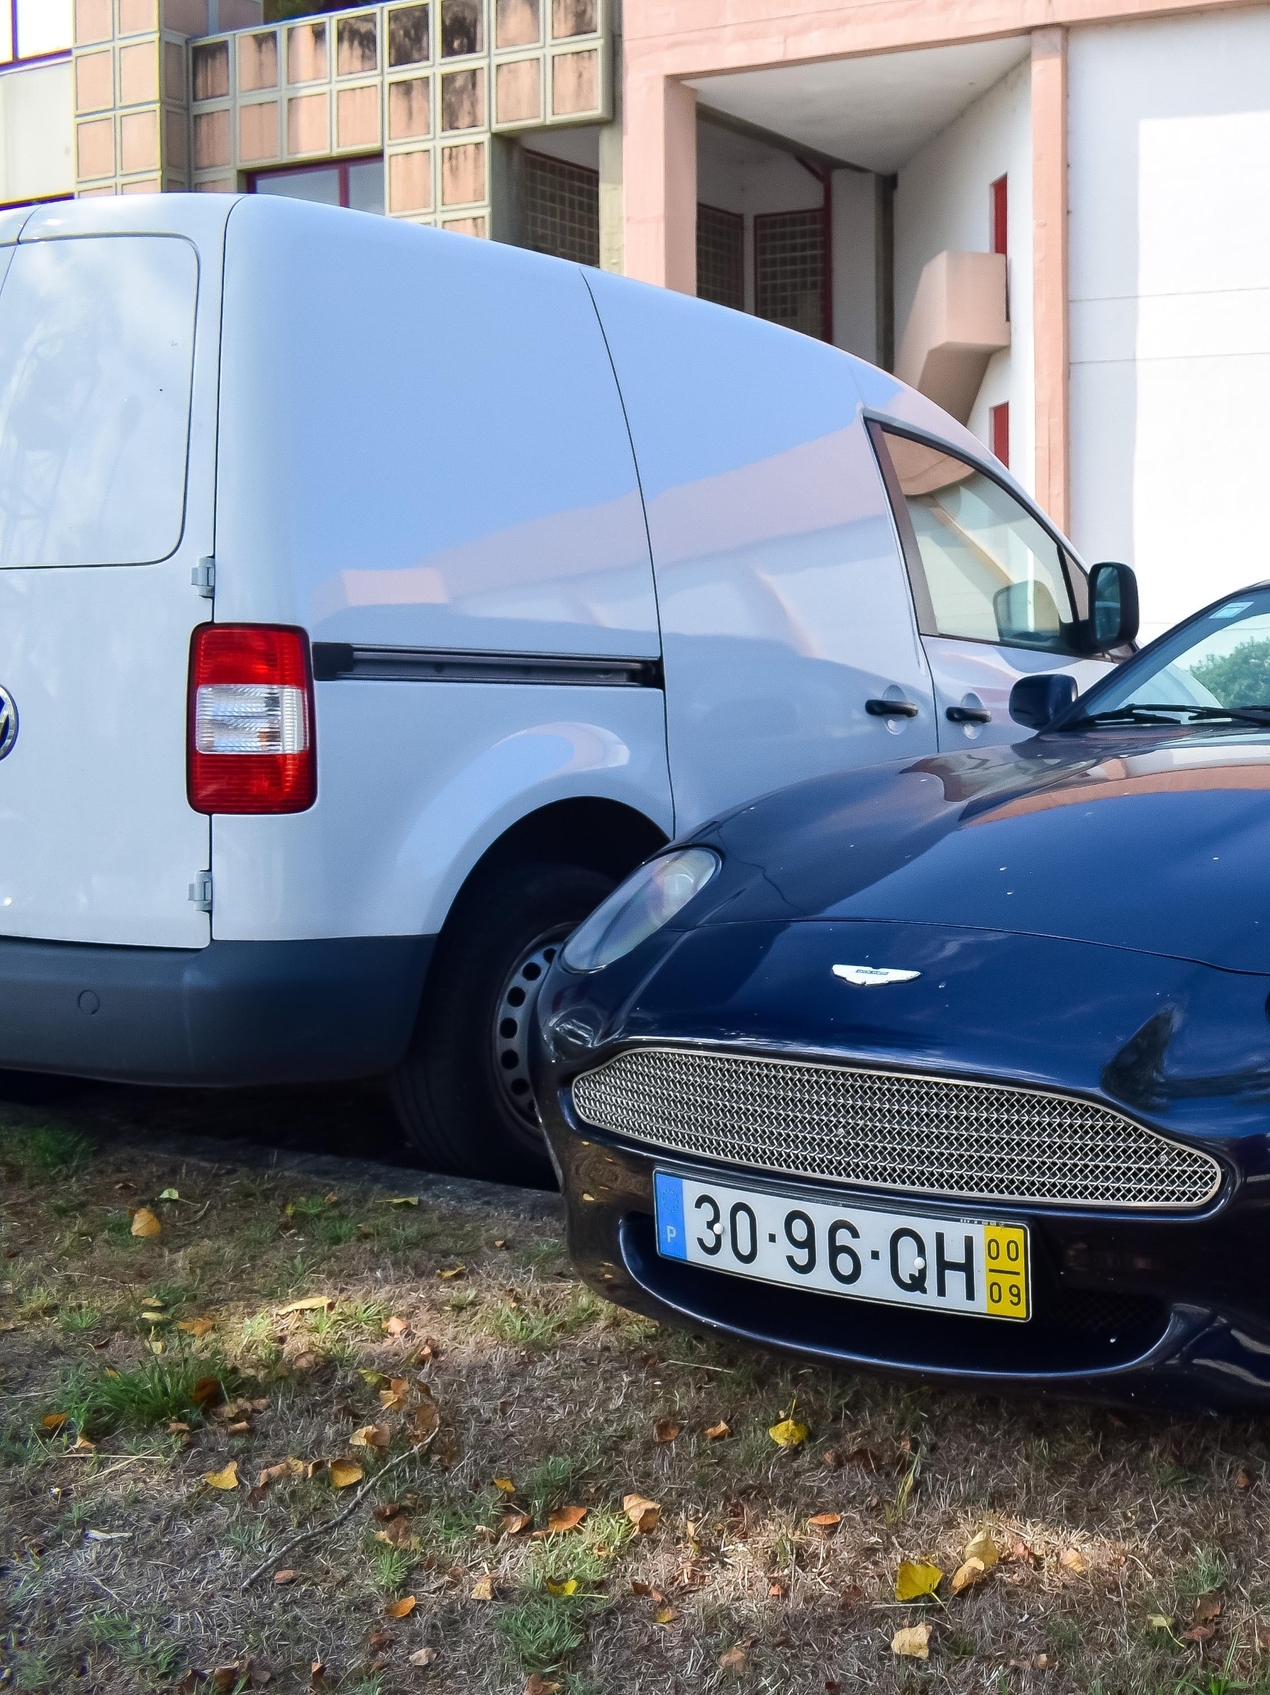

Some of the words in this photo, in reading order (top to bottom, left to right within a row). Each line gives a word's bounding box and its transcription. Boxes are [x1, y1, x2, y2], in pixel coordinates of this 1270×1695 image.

[666, 1225, 677, 1243] P
[987, 1238, 1020, 1262] 00
[988, 1281, 1022, 1306] 09
